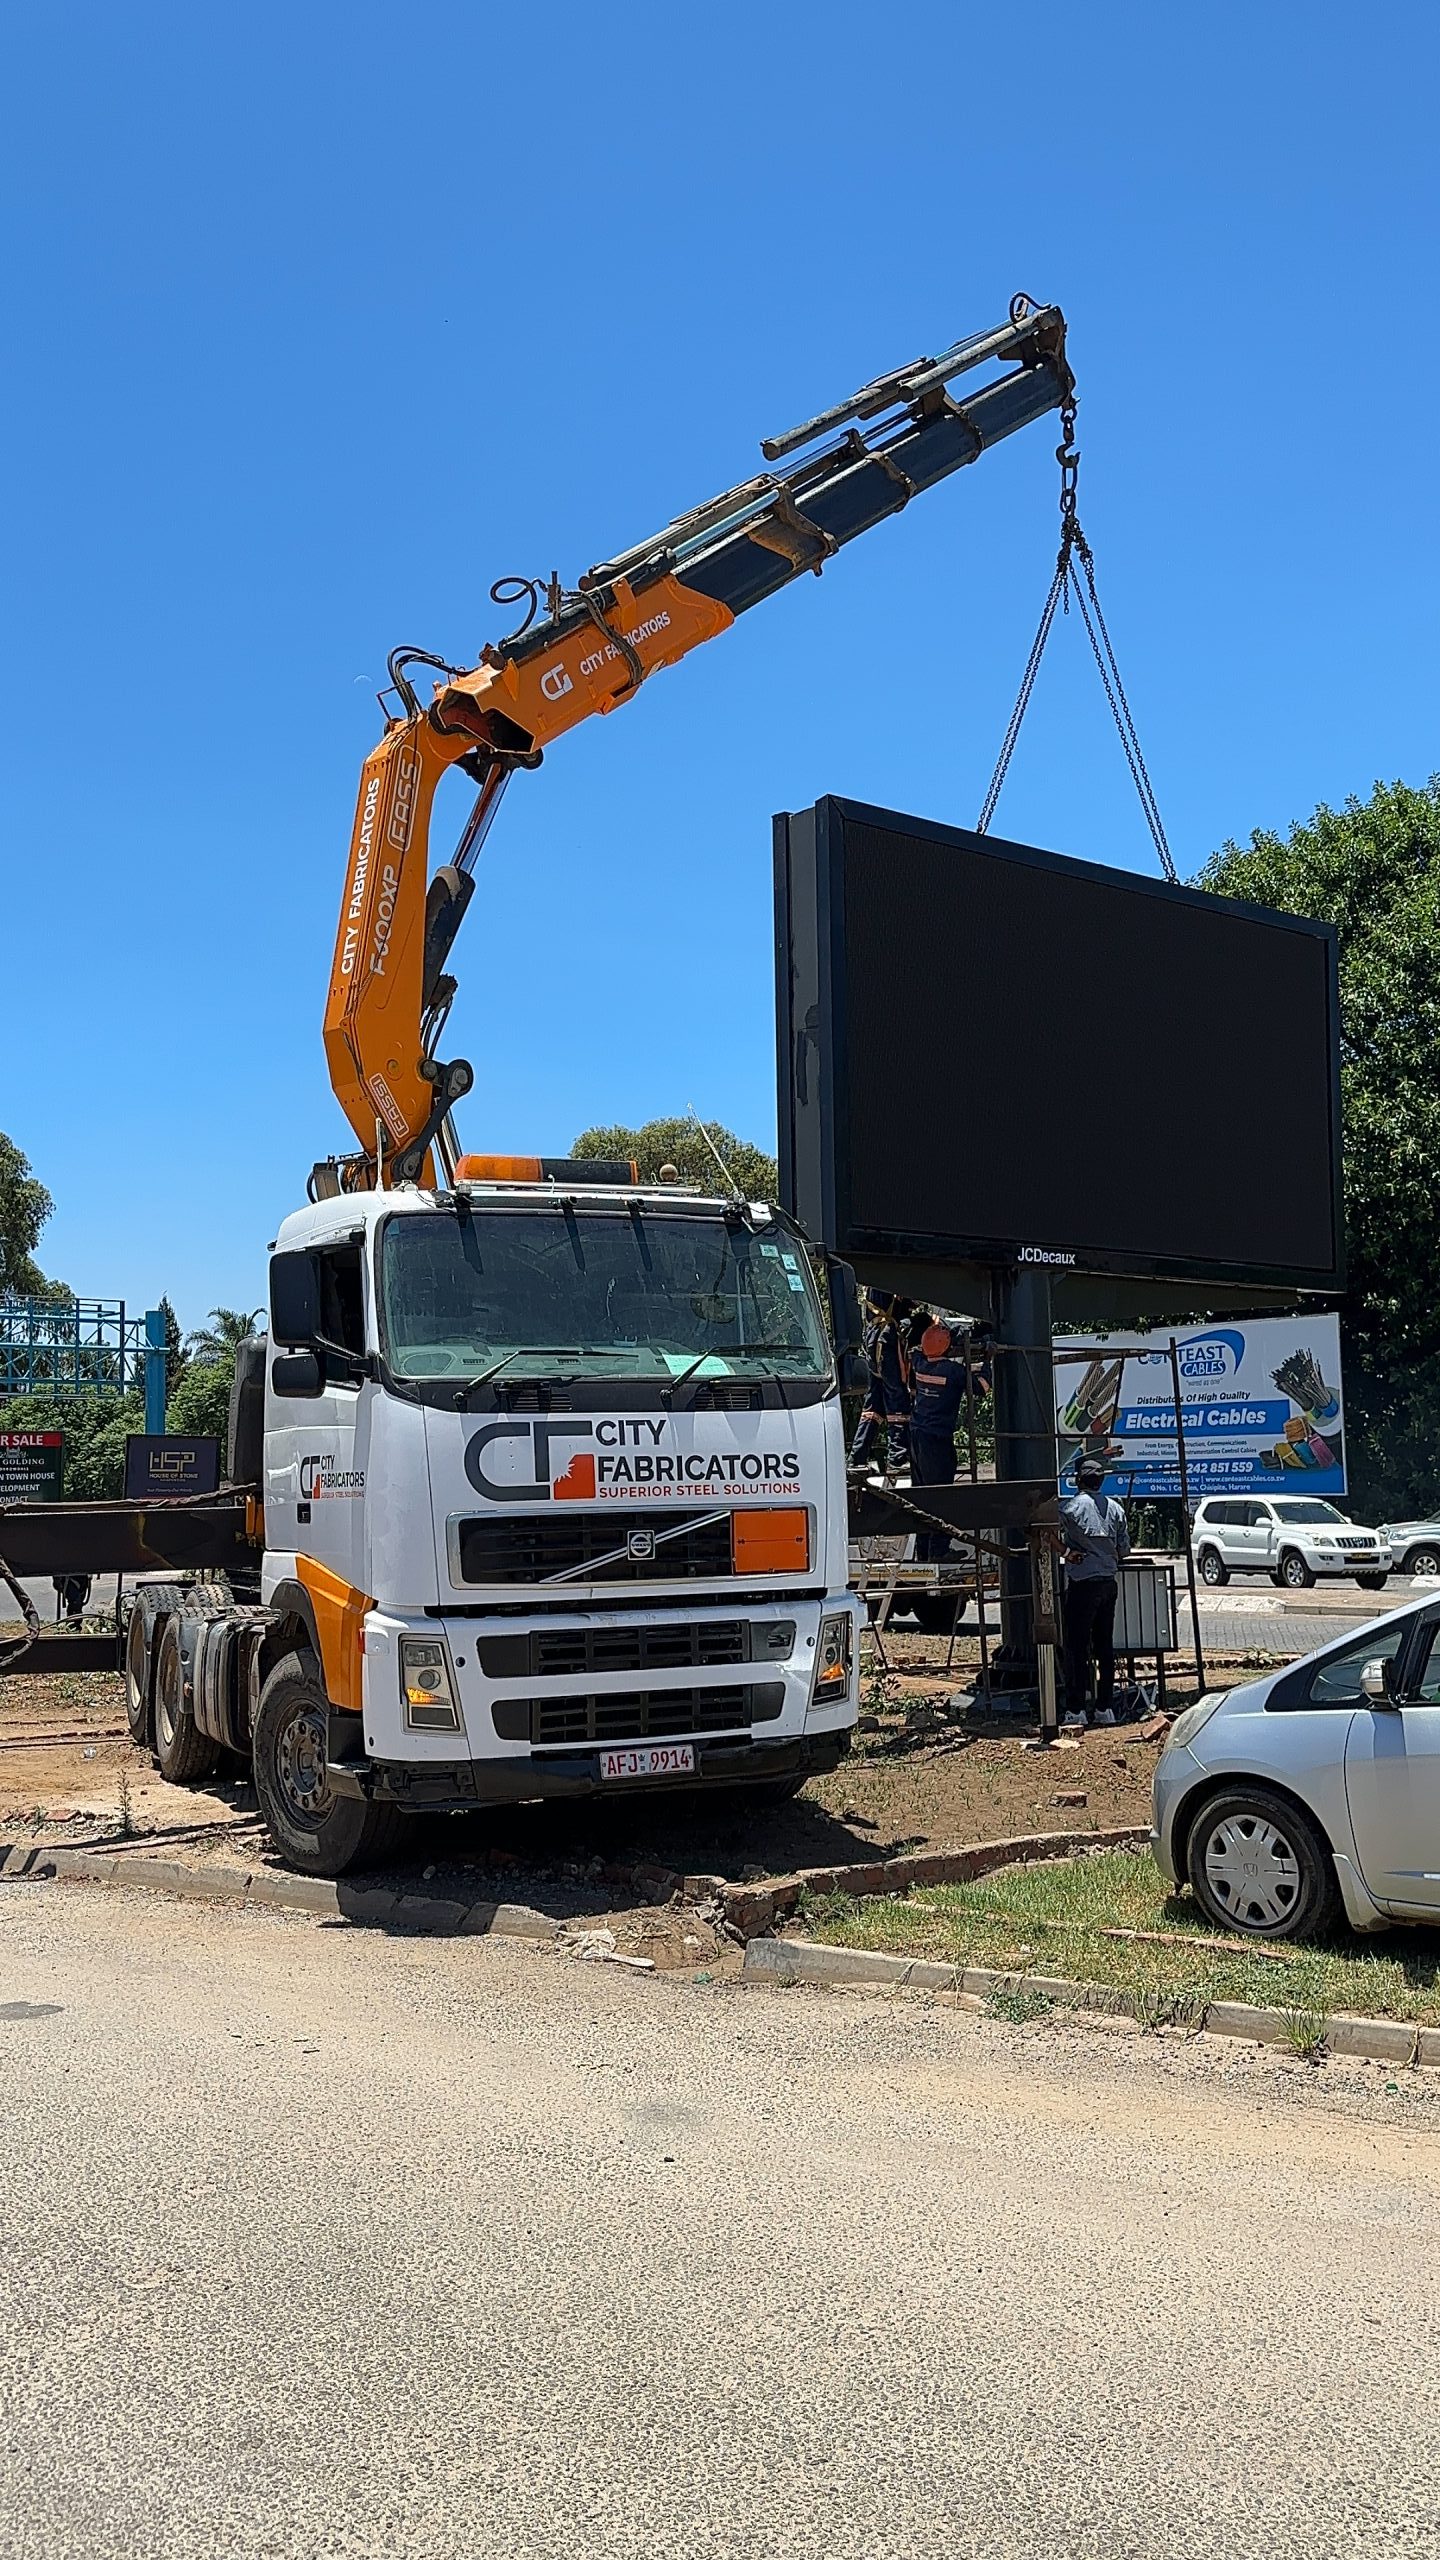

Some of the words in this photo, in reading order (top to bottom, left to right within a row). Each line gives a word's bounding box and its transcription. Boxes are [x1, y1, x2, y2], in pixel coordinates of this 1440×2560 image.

[580, 649, 606, 676] CITY
[604, 611, 671, 661] FARICATORS
[348, 777, 380, 920] FABRICATORS
[341, 927, 359, 975] CITY
[373, 1078, 405, 1132] FASSI
[1017, 1247, 1076, 1265] JCDecaux
[1183, 1361, 1224, 1377] CABLES
[1137, 1394, 1184, 1405] Distributos
[1186, 1393, 1197, 1403] Of
[1197, 1392, 1218, 1404] High
[1219, 1390, 1251, 1403] Quality
[1206, 1408, 1267, 1427] Cables
[12, 1435, 44, 1446] SALE
[595, 1419, 667, 1446] CITY
[321, 1454, 336, 1471] CITY
[597, 1453, 801, 1482] FABRICATORS
[1186, 1462, 1208, 1474] 242
[1210, 1462, 1230, 1474] 851
[1231, 1461, 1254, 1473] 559
[5, 1473, 29, 1481] TOWN
[30, 1472, 56, 1480] HOUSE
[320, 1471, 365, 1489] FABRICATORS
[0, 1484, 40, 1492] ELOPMENT
[599, 1486, 673, 1498] SUPERIOR
[676, 1484, 722, 1496] STEEL
[723, 1482, 801, 1495] SOLUTIONS
[1228, 1483, 1251, 1491] Harare
[607, 1753, 638, 1775] AFJ
[650, 1749, 690, 1771] 9914
